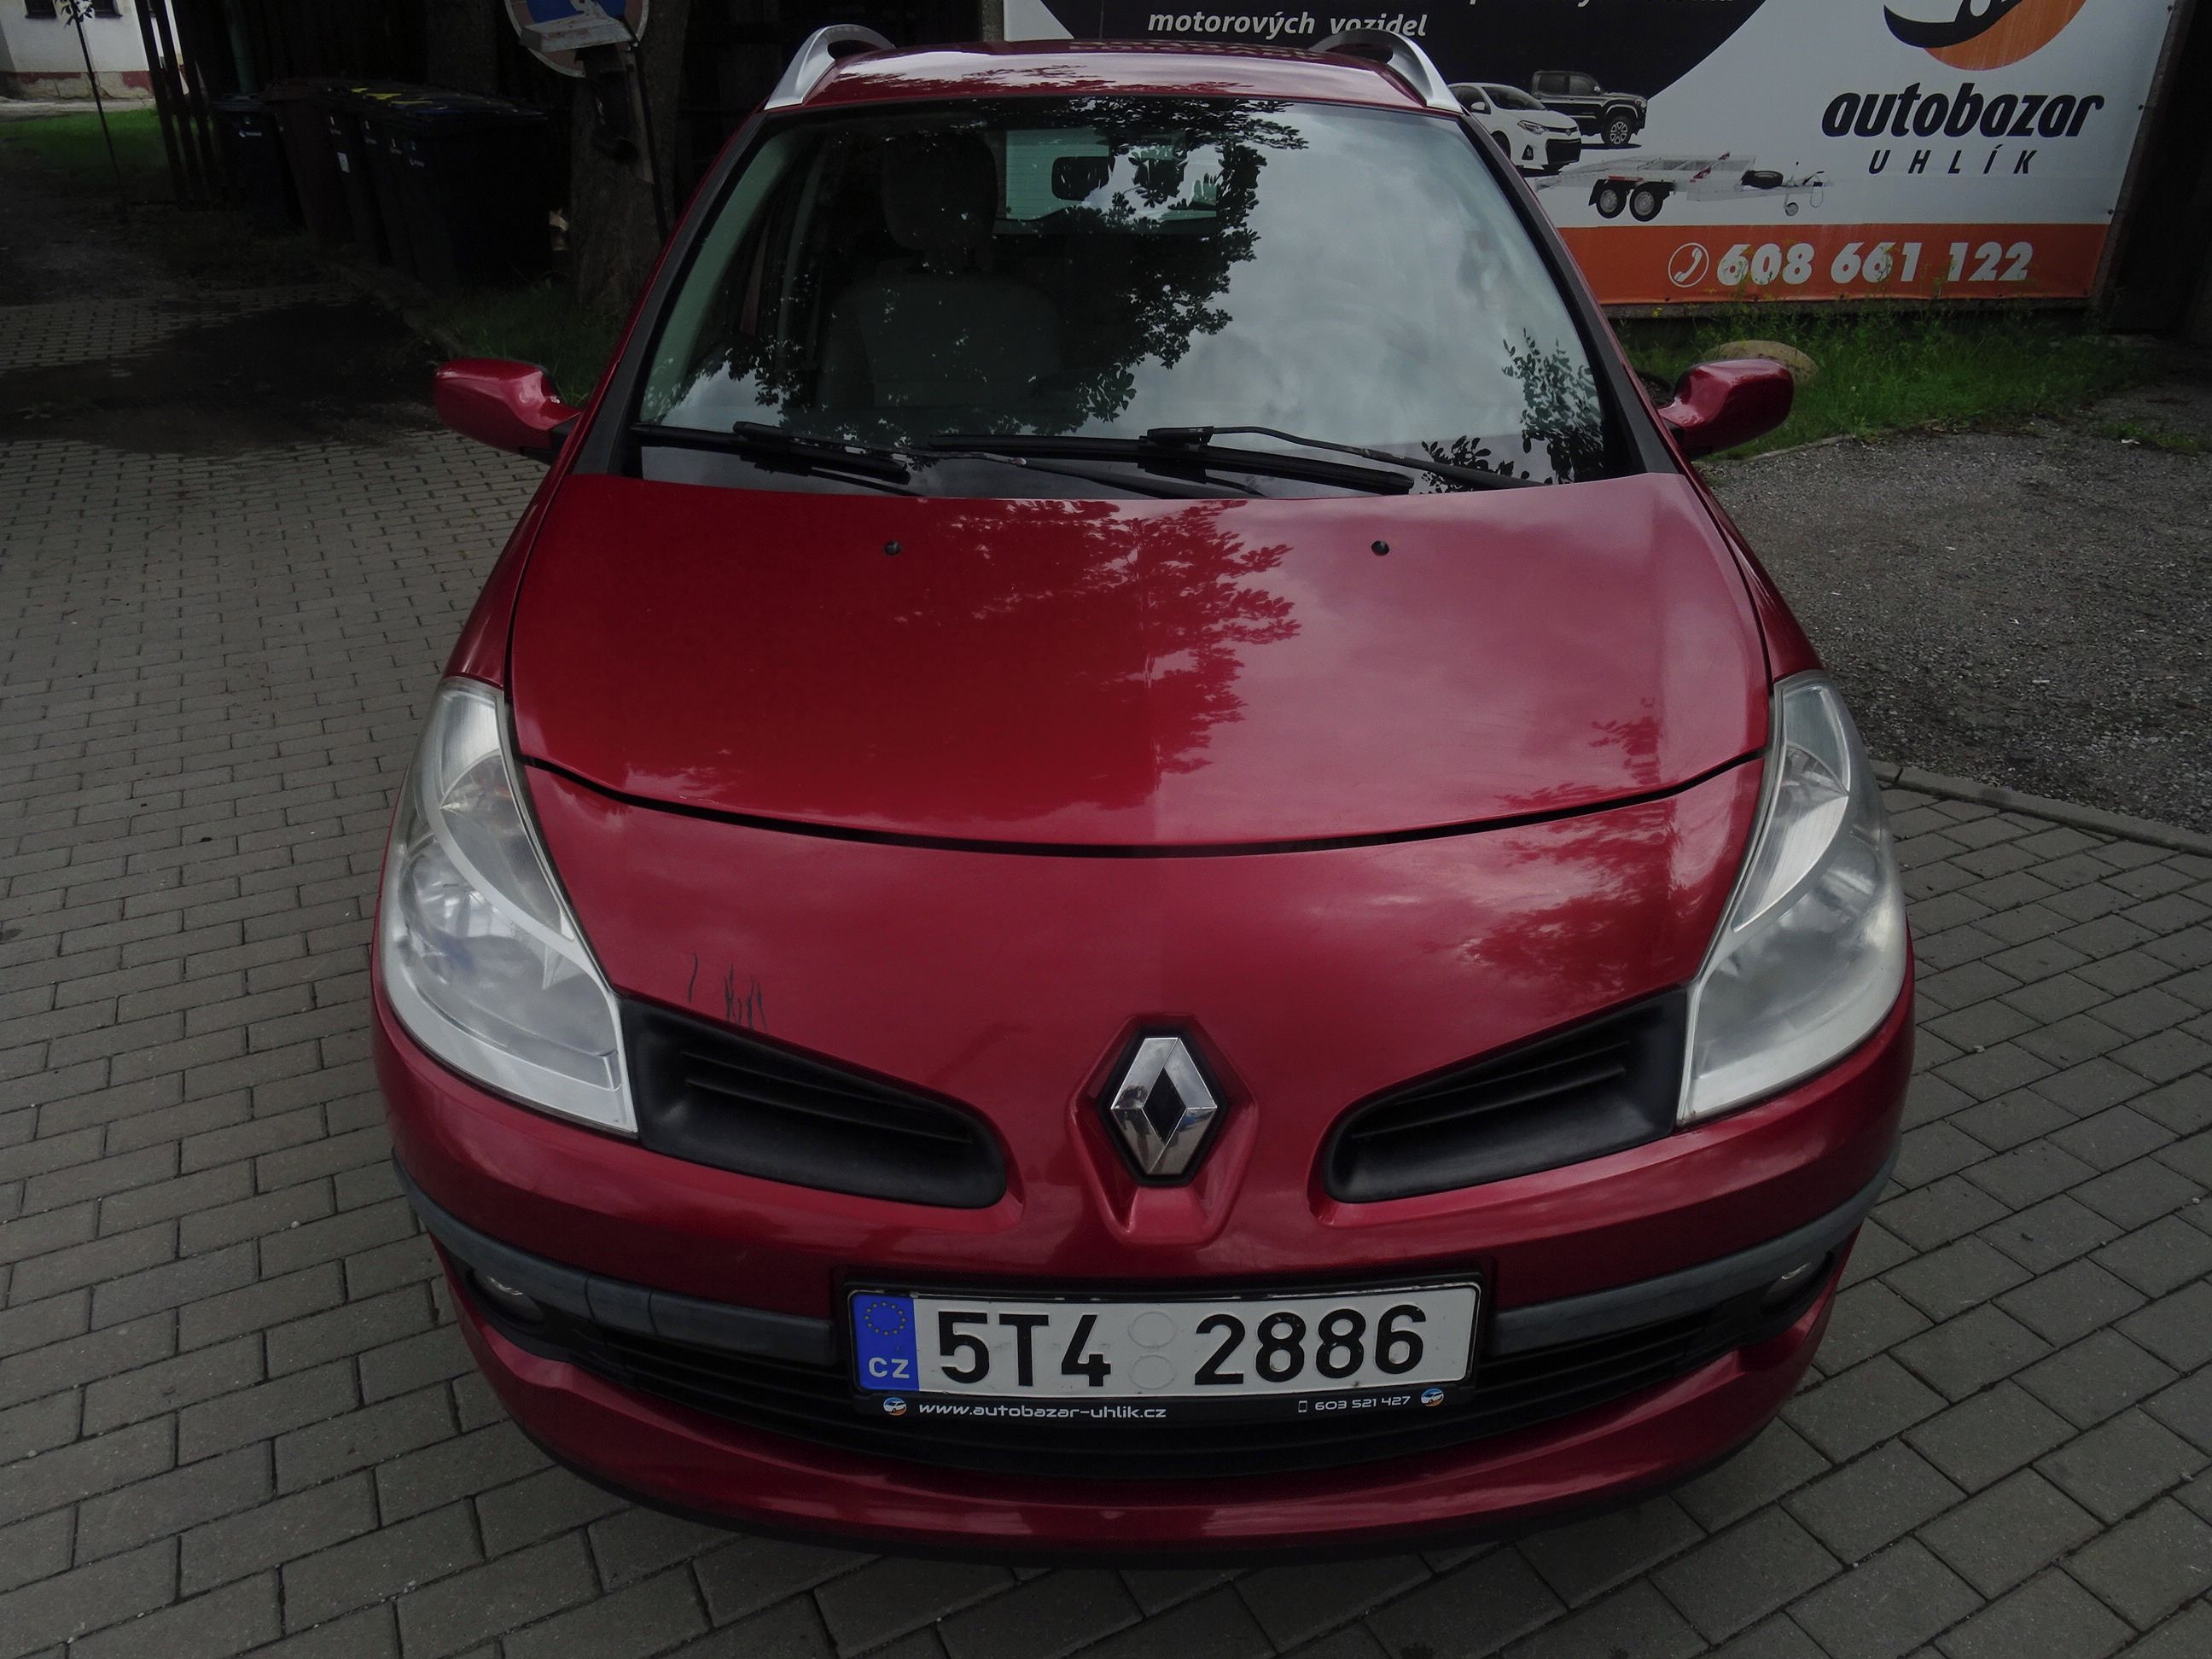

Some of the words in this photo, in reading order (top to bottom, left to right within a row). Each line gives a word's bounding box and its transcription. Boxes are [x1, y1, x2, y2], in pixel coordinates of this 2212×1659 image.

[1148, 11, 1315, 40] motorových
[1330, 14, 1428, 37] vozidel
[1821, 82, 2105, 138] autobazar
[1868, 143, 2038, 175] UHLÍK
[1716, 242, 1815, 286] 608
[1831, 242, 1923, 284] 661
[1947, 242, 2034, 282] 122
[937, 1310, 1112, 1388] 5T4
[1193, 1303, 1428, 1386] 2886
[868, 1357, 911, 1379] CZ
[918, 1403, 1167, 1419] www.autobazar-uhlik.cz
[1314, 1400, 1348, 1412] 603
[1351, 1398, 1377, 1408] 521
[1381, 1395, 1412, 1406] 427
